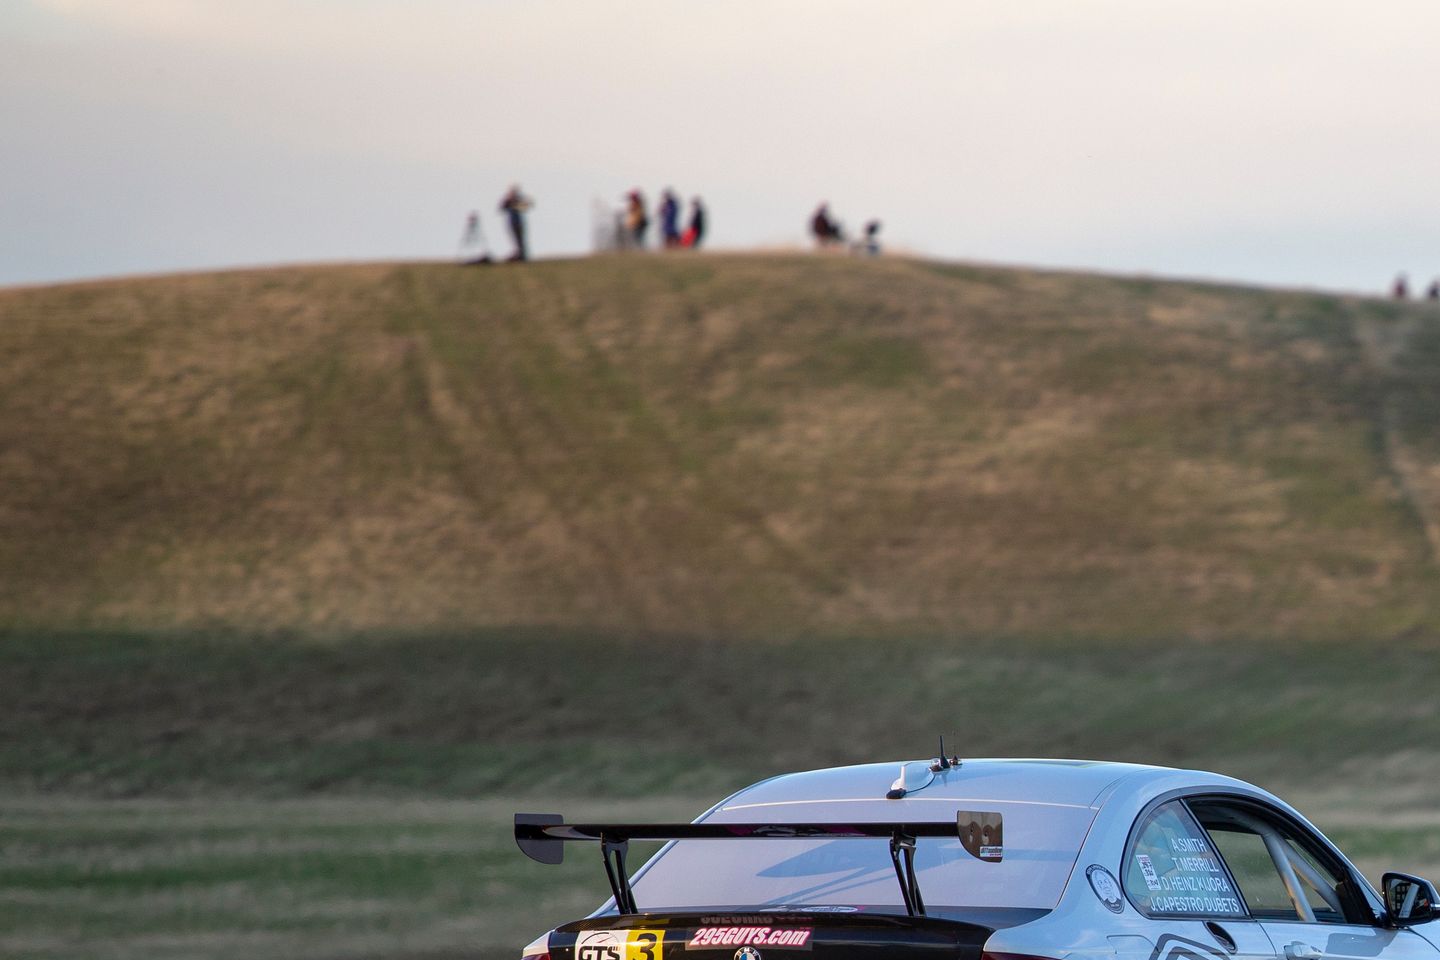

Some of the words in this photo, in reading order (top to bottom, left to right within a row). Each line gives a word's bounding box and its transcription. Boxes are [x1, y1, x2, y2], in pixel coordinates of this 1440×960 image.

[1171, 838, 1207, 853] A.SMITH
[1203, 897, 1239, 912] DUBETS
[689, 927, 812, 946] 295GUYS.com
